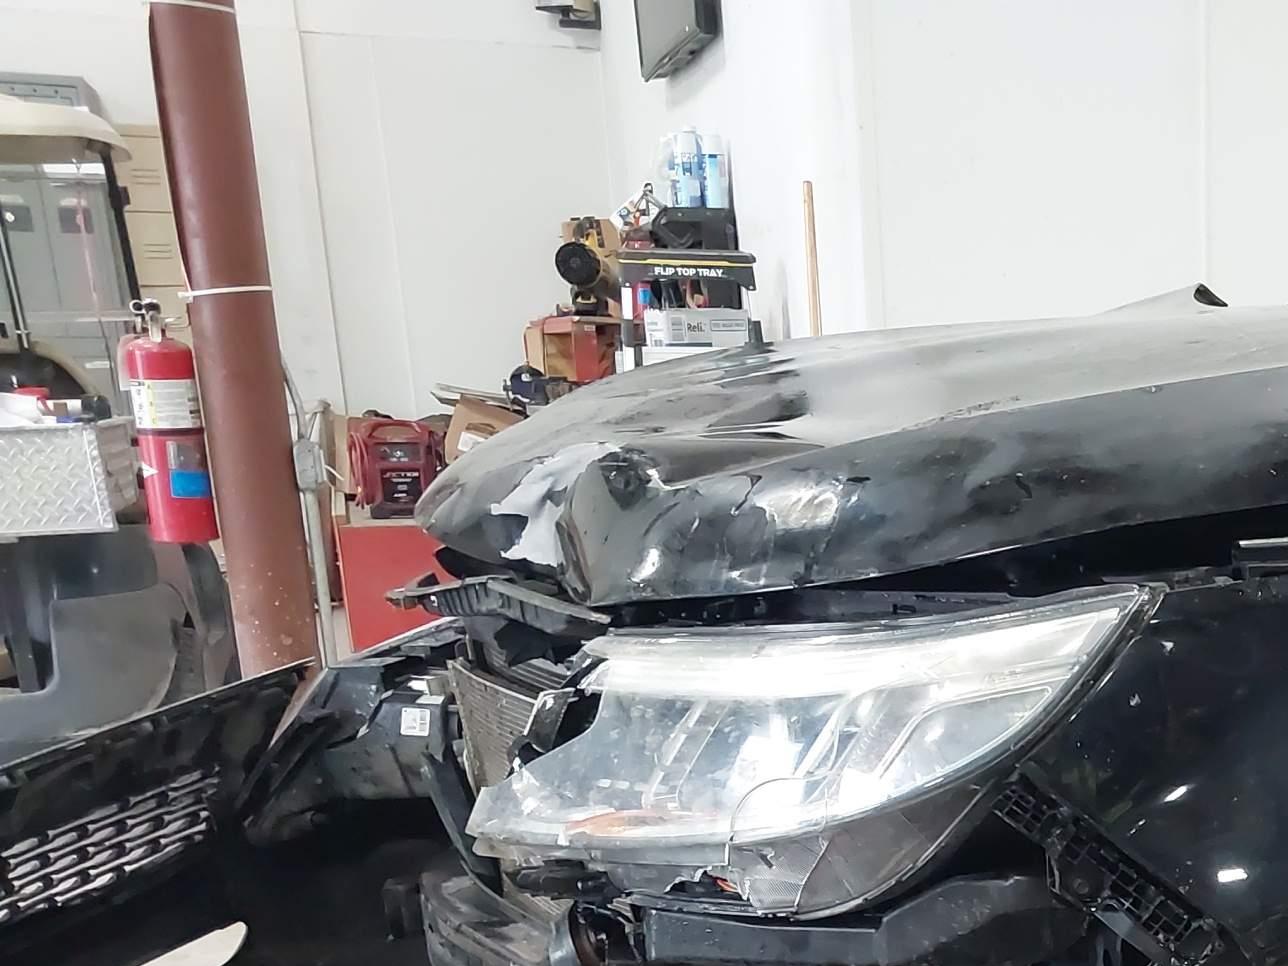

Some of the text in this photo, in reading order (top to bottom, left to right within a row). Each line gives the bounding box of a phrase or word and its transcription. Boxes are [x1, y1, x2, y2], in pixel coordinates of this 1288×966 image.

[653, 266, 724, 278] FLIP TOP TRAY
